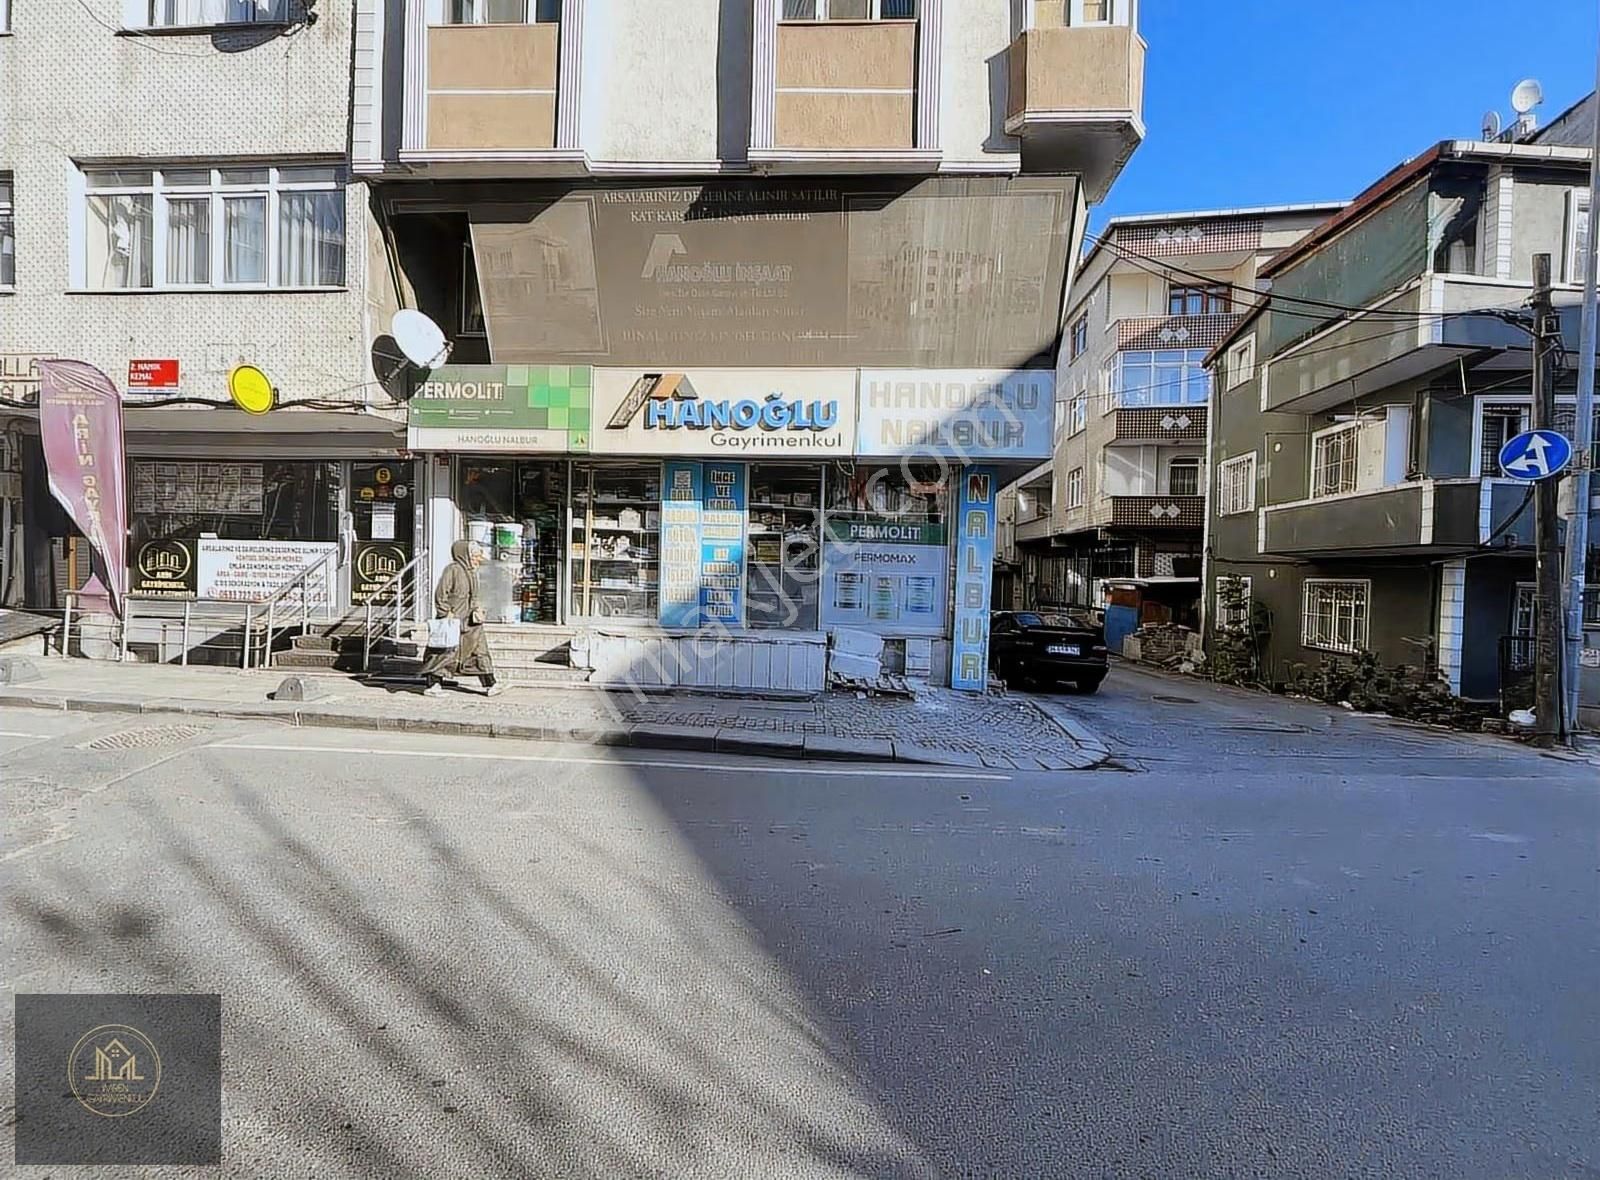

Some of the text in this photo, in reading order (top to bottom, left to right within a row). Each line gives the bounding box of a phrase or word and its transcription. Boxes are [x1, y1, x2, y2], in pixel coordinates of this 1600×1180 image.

[602, 191, 680, 204] ARSALARINIZ
[630, 210, 655, 222] KAT
[644, 391, 838, 430] HANOĞLU
[502, 435, 538, 444] NALBUR
[710, 432, 842, 450] Gayrimenkul
[880, 418, 1025, 448] NALBUR
[854, 551, 917, 565] PERMOMAX
[960, 473, 991, 682] NALBUR
